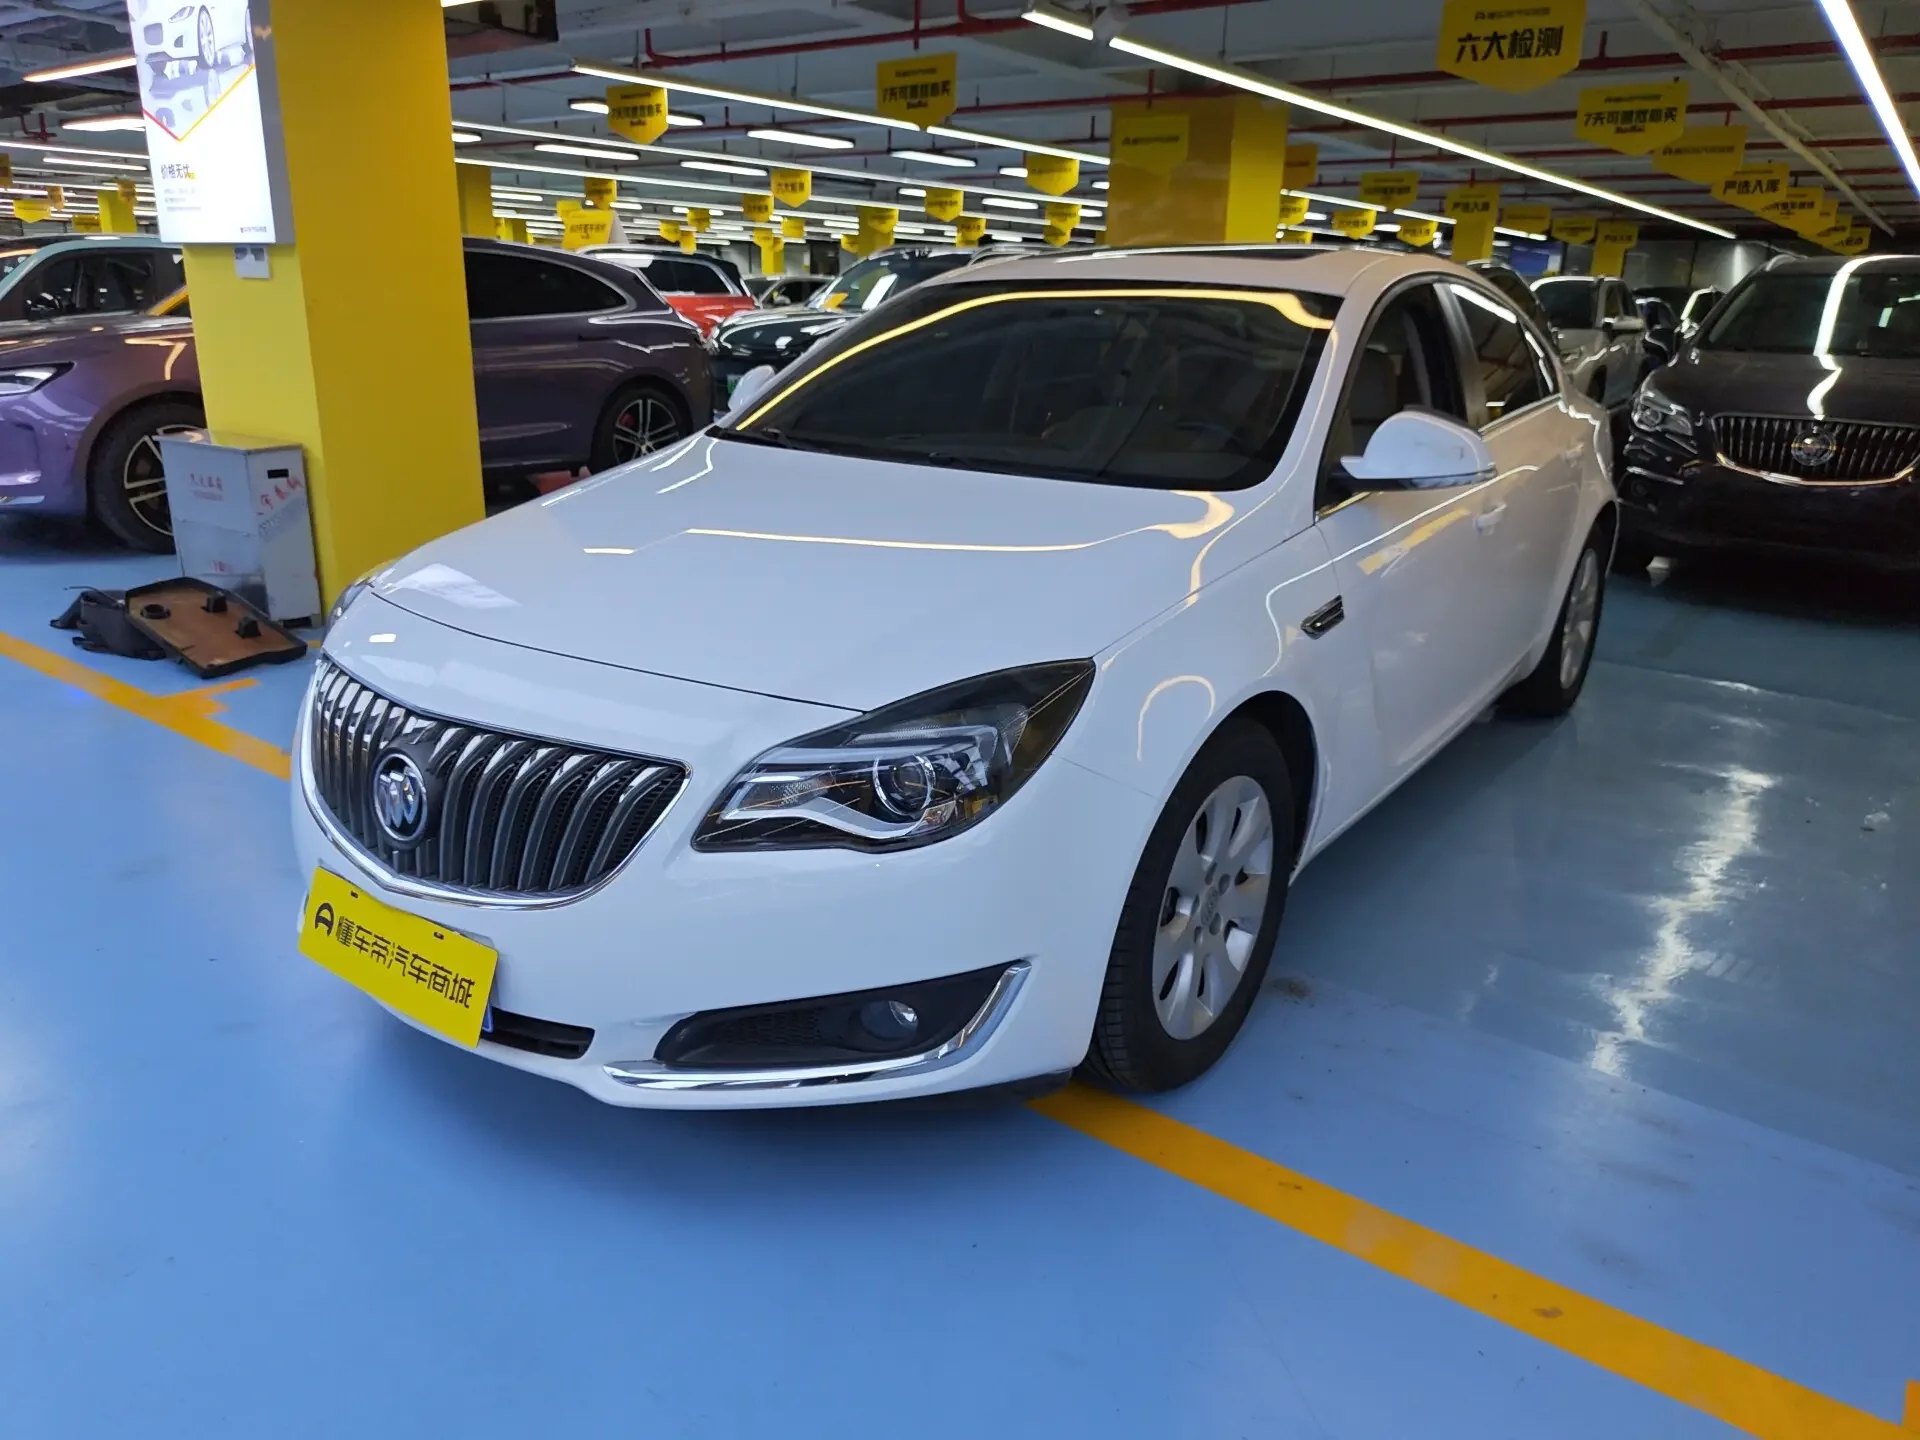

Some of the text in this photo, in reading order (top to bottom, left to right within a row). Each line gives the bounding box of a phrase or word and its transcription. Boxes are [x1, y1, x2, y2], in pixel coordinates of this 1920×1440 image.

[1455, 25, 1564, 63] 六大检测
[335, 915, 476, 1009] 懂车帝汽车商城
